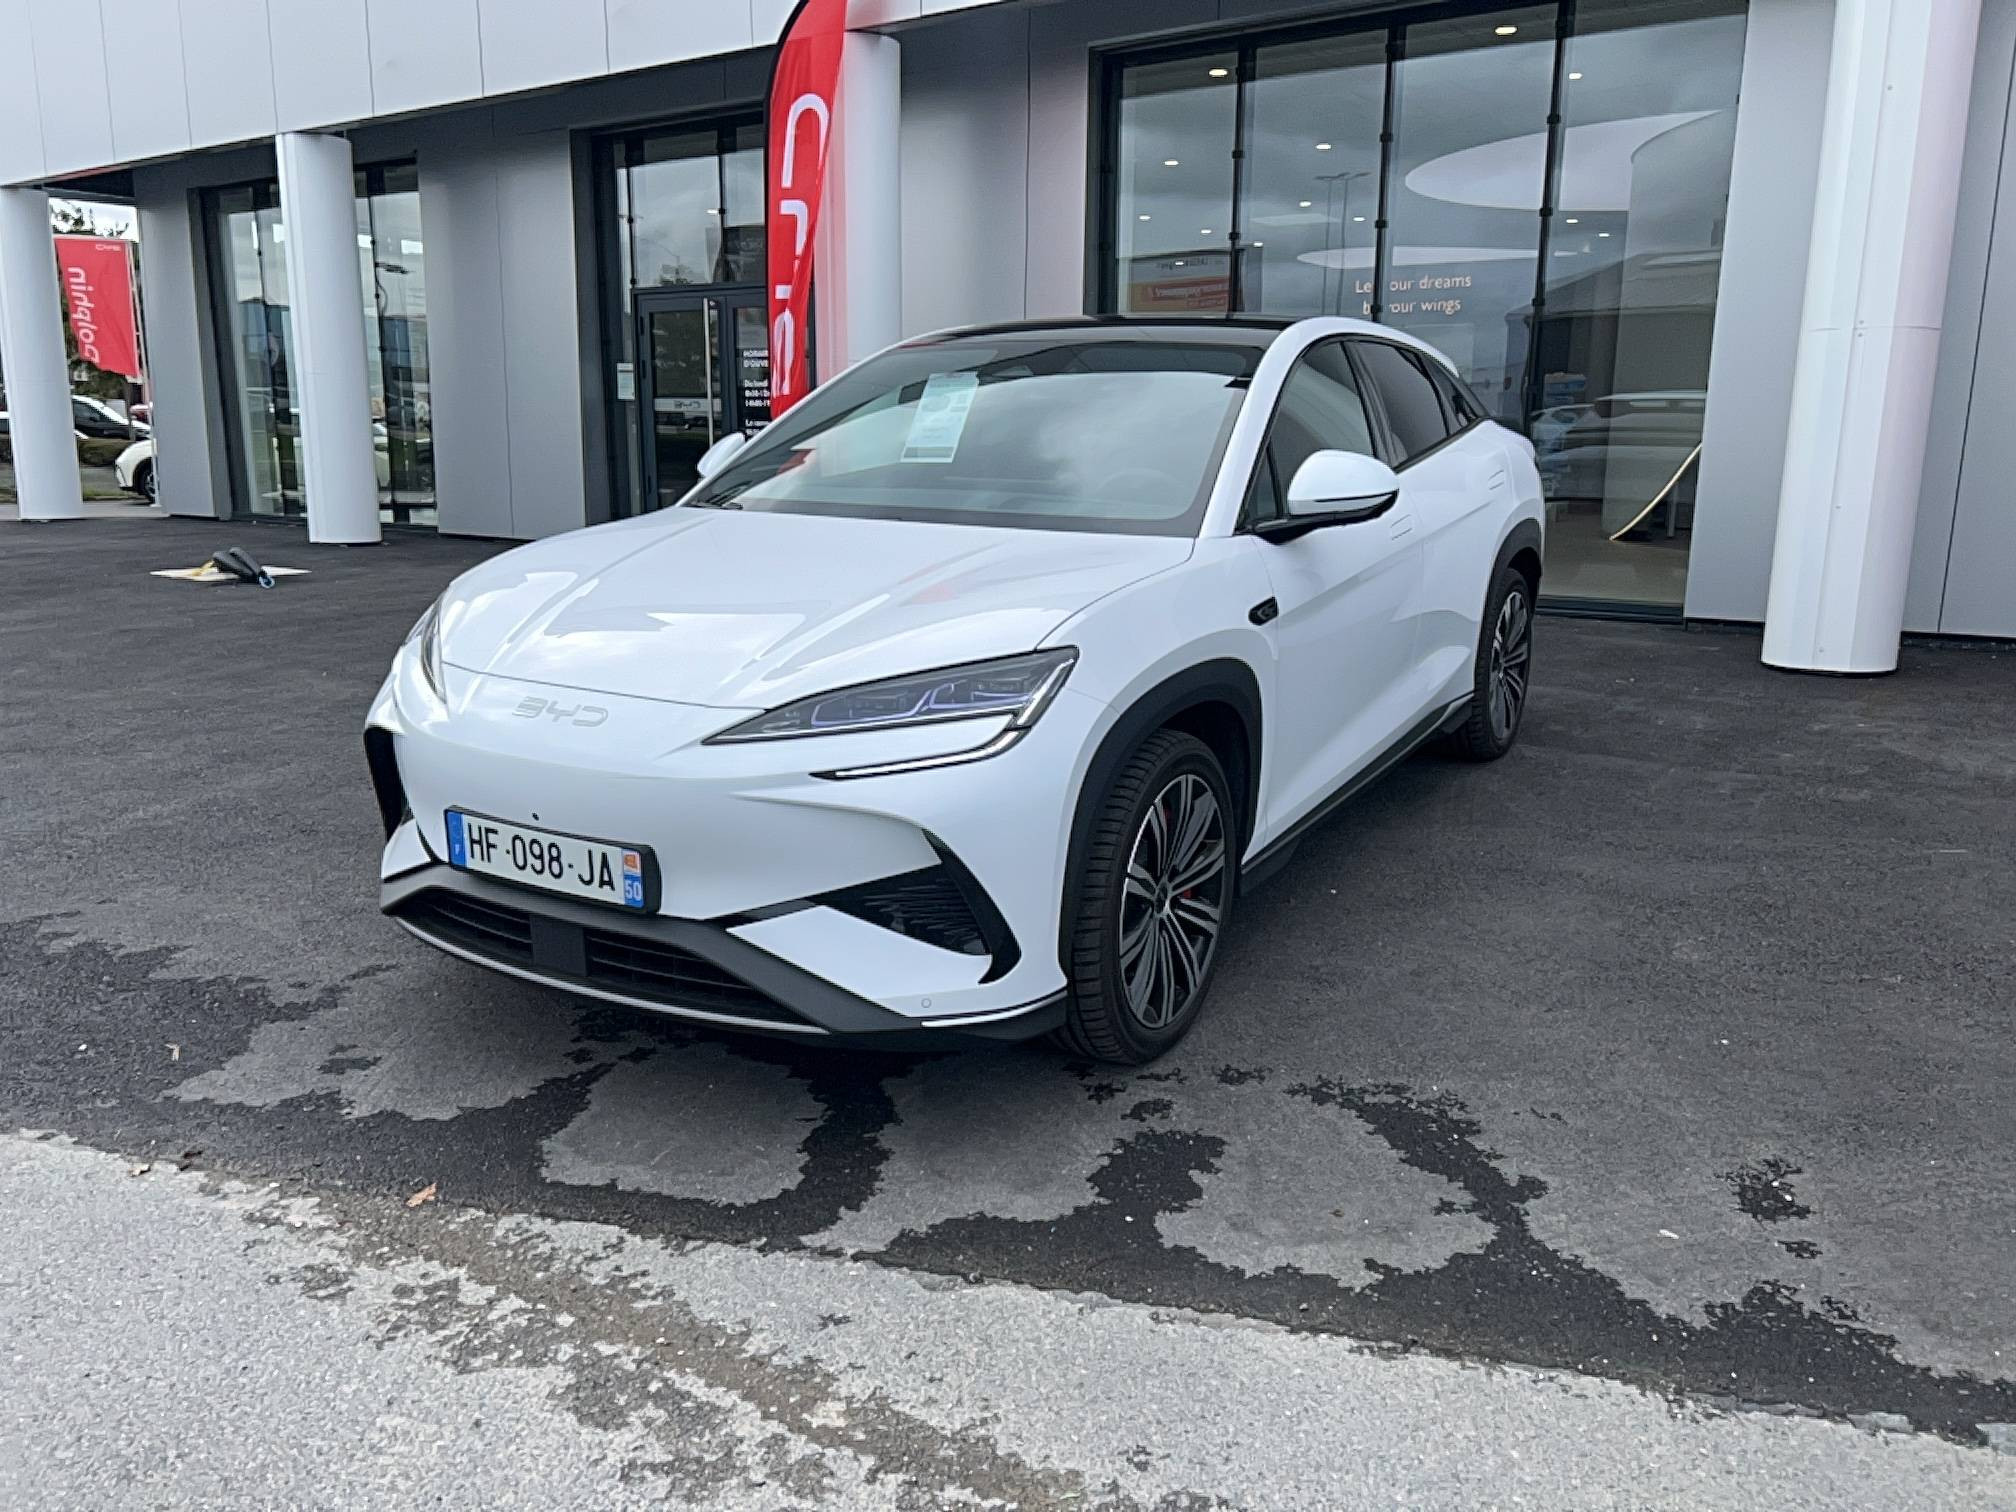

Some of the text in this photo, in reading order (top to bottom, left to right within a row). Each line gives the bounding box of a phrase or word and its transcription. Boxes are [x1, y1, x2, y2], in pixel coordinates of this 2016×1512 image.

[1355, 275, 1472, 293] Le our dreams
[1388, 301, 1416, 314] our
[1420, 299, 1461, 316] wings
[511, 695, 609, 728] BYD
[467, 822, 616, 891] HF-098-JA
[623, 880, 642, 900] 50
